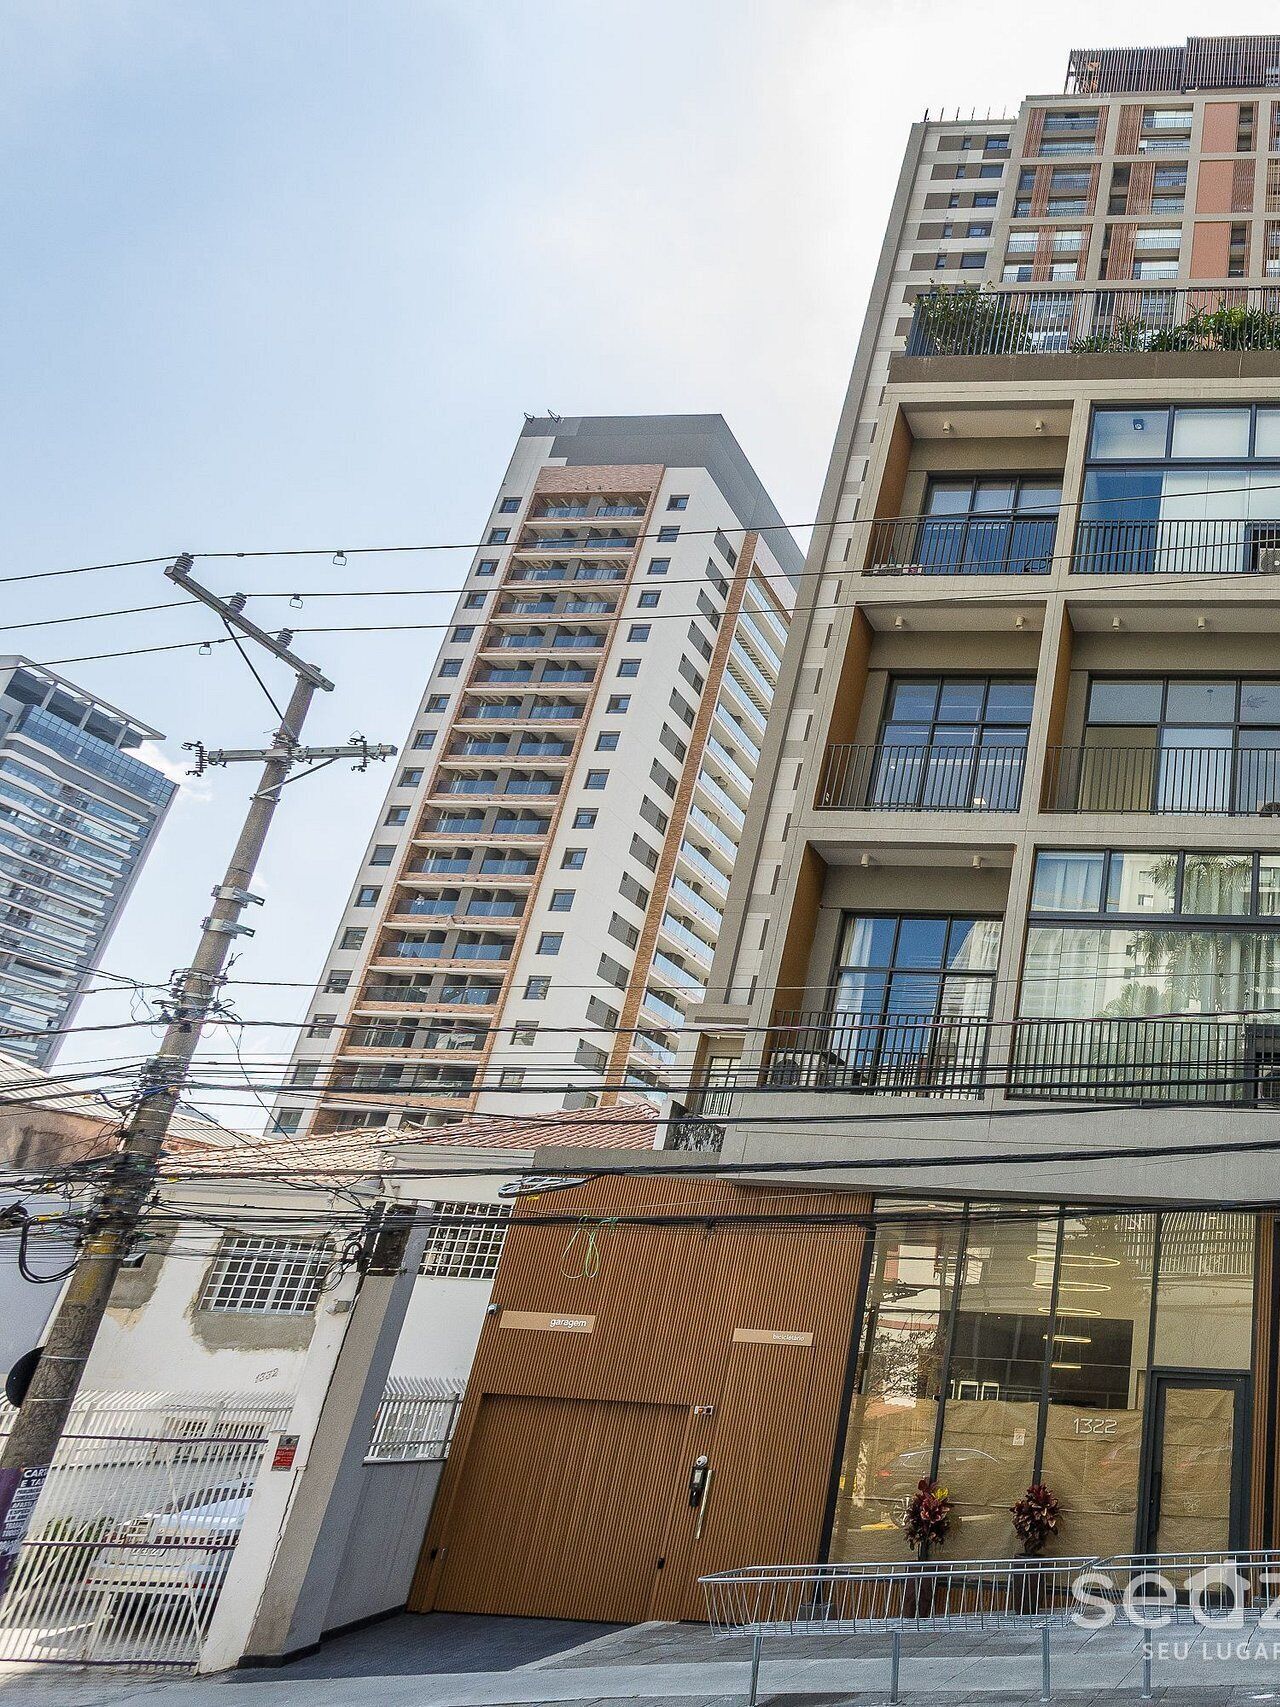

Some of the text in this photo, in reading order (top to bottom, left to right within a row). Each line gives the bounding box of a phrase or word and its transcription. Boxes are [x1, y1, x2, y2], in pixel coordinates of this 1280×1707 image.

[549, 1318, 587, 1329] garagem
[254, 1367, 279, 1384] 1332
[1073, 1417, 1118, 1434] 1322
